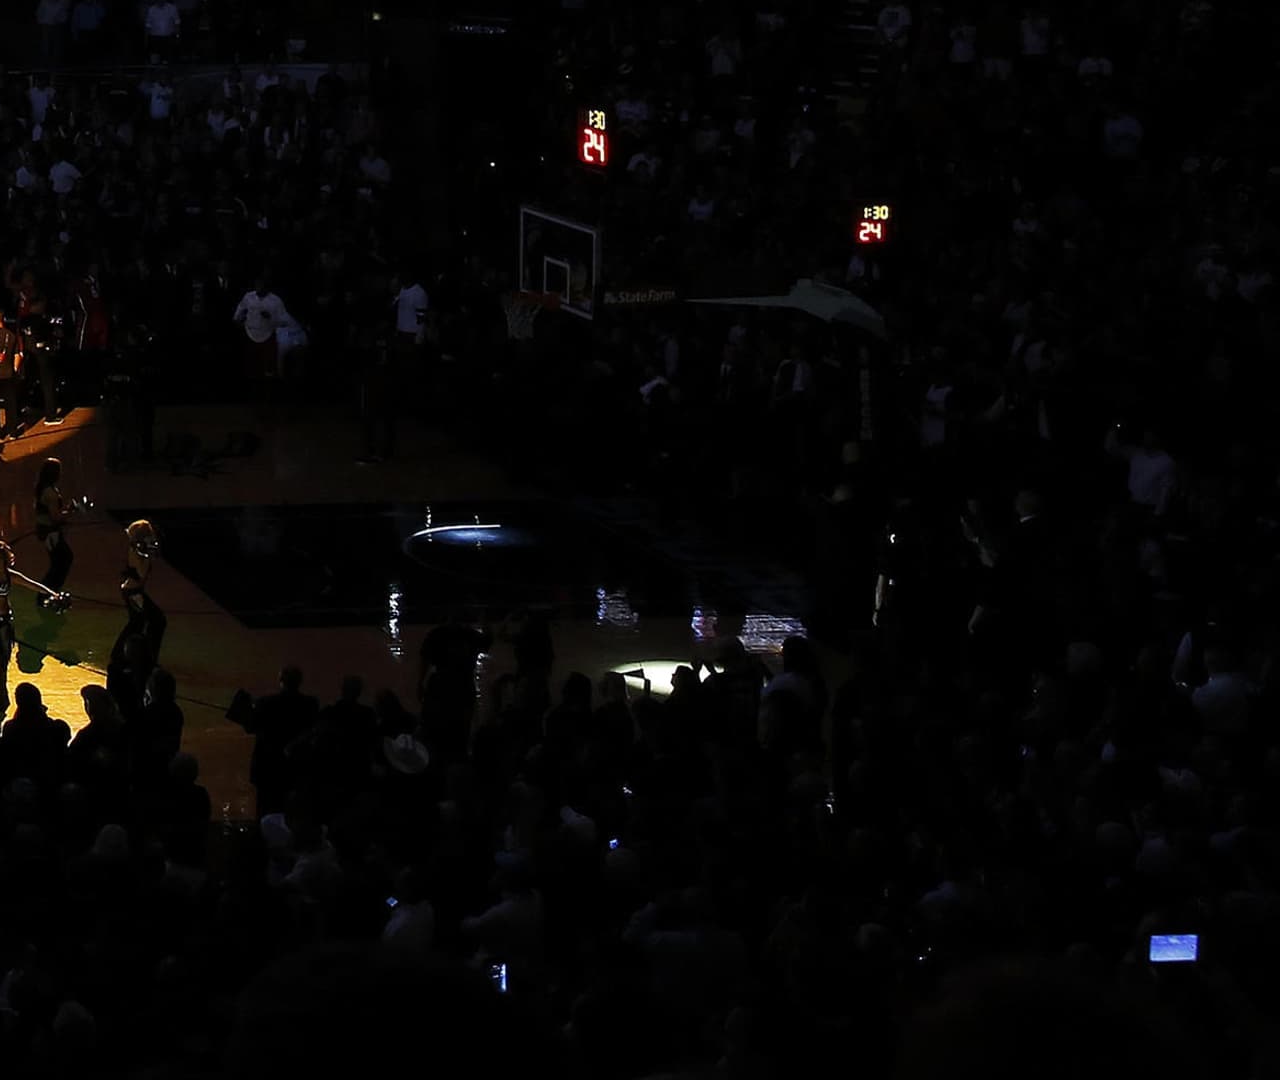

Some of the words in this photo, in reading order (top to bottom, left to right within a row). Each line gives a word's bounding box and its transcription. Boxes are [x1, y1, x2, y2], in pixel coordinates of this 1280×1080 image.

[583, 129, 605, 163] 24
[864, 205, 889, 220] 1:30
[859, 222, 882, 241] 24
